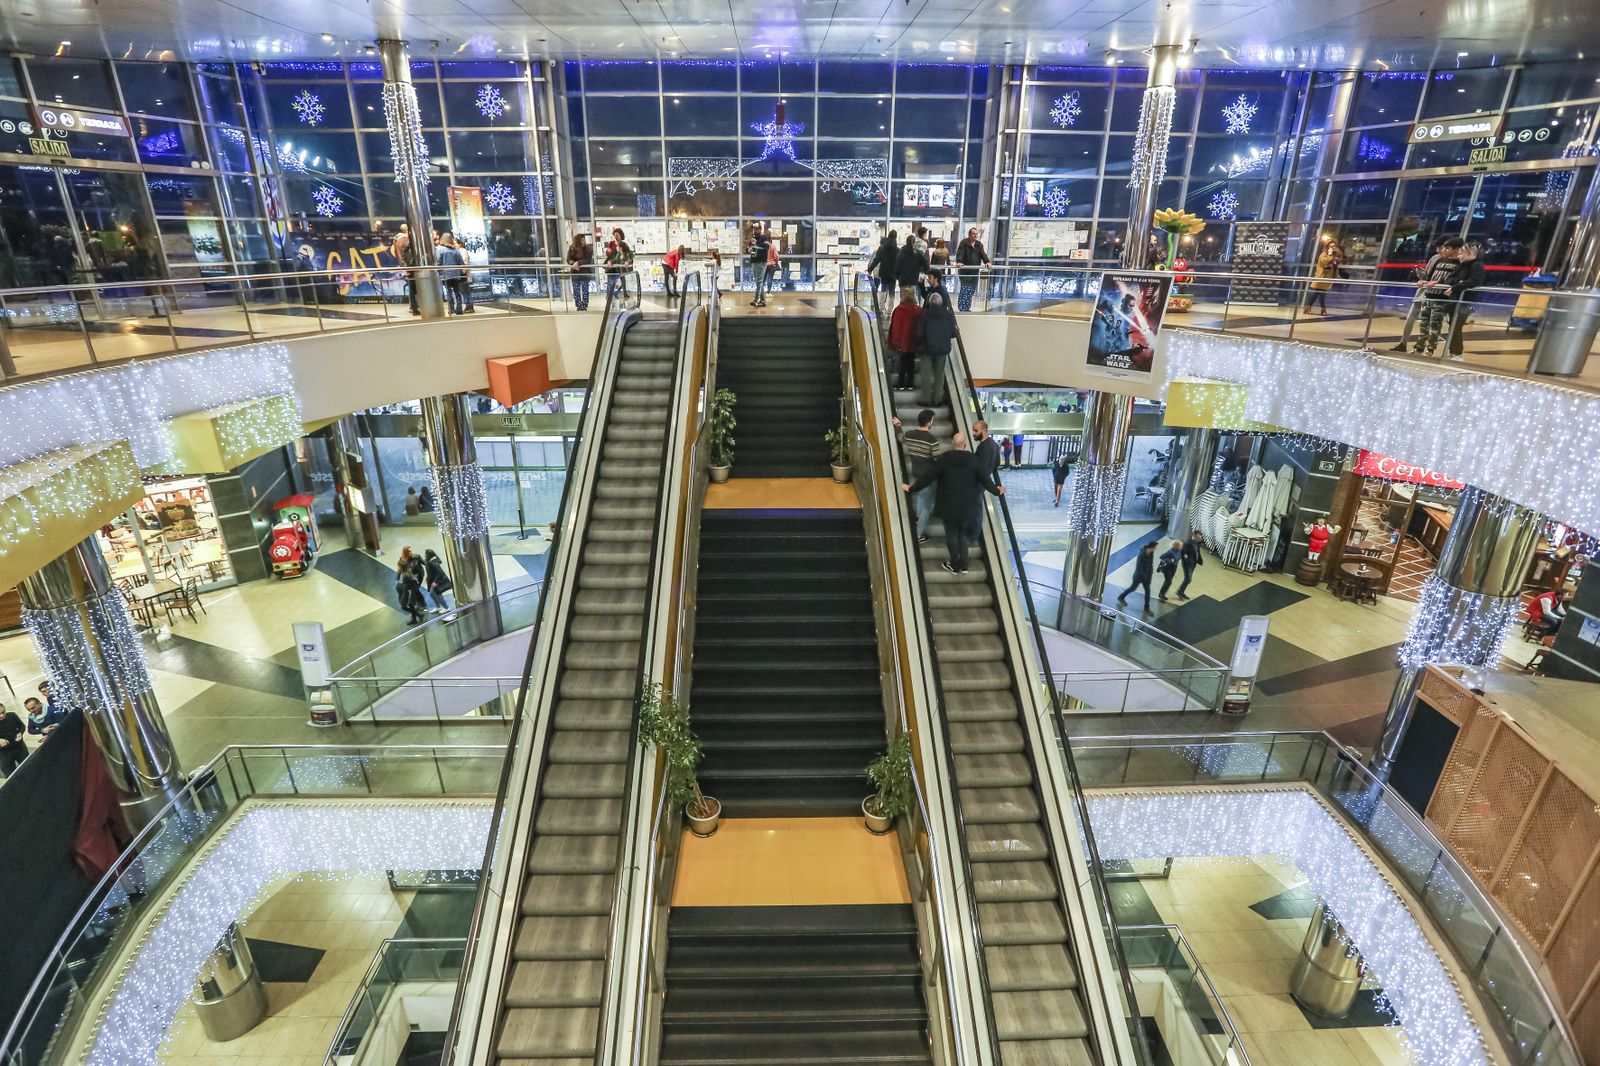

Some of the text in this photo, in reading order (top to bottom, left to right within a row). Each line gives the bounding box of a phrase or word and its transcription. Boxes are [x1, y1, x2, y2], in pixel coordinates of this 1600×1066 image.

[31, 140, 69, 157] SALIDA
[1471, 148, 1503, 163] SALIDA
[327, 244, 397, 295] CAT
[1106, 353, 1132, 362] STAR
[1106, 360, 1131, 369] WARS
[501, 418, 521, 427] SALIDA
